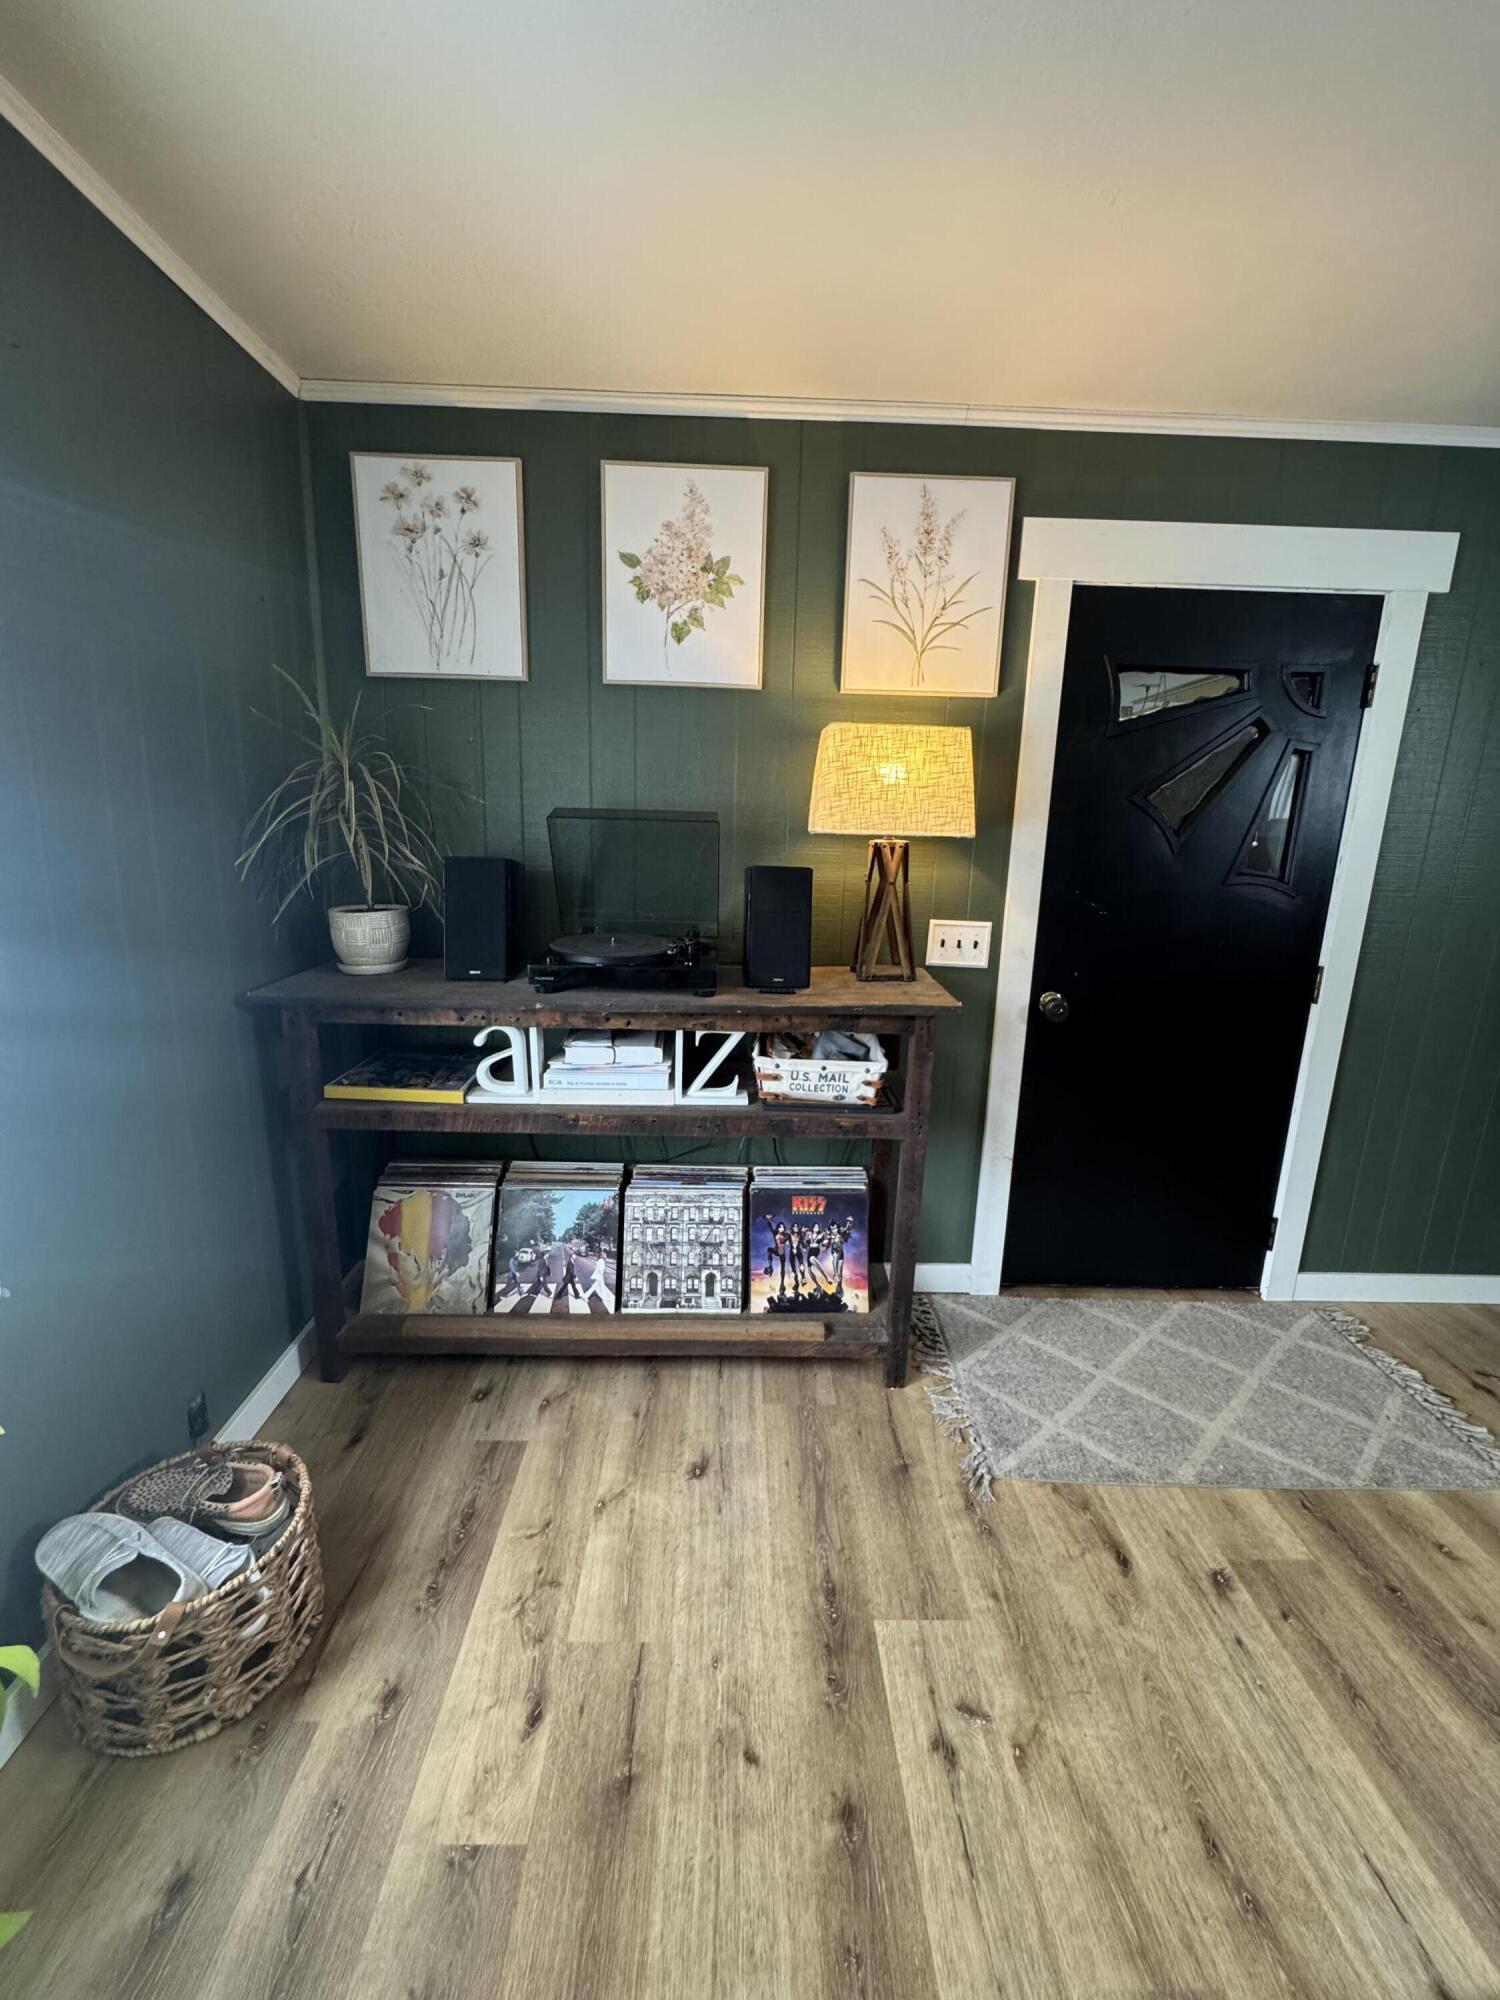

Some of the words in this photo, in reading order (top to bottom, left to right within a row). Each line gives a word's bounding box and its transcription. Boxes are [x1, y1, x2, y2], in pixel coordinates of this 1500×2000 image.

[790, 1071, 812, 1082] U.S.
[818, 1072, 850, 1084] MAIL
[789, 1082, 849, 1093] COLLECTION
[792, 1196, 828, 1212] KISS
